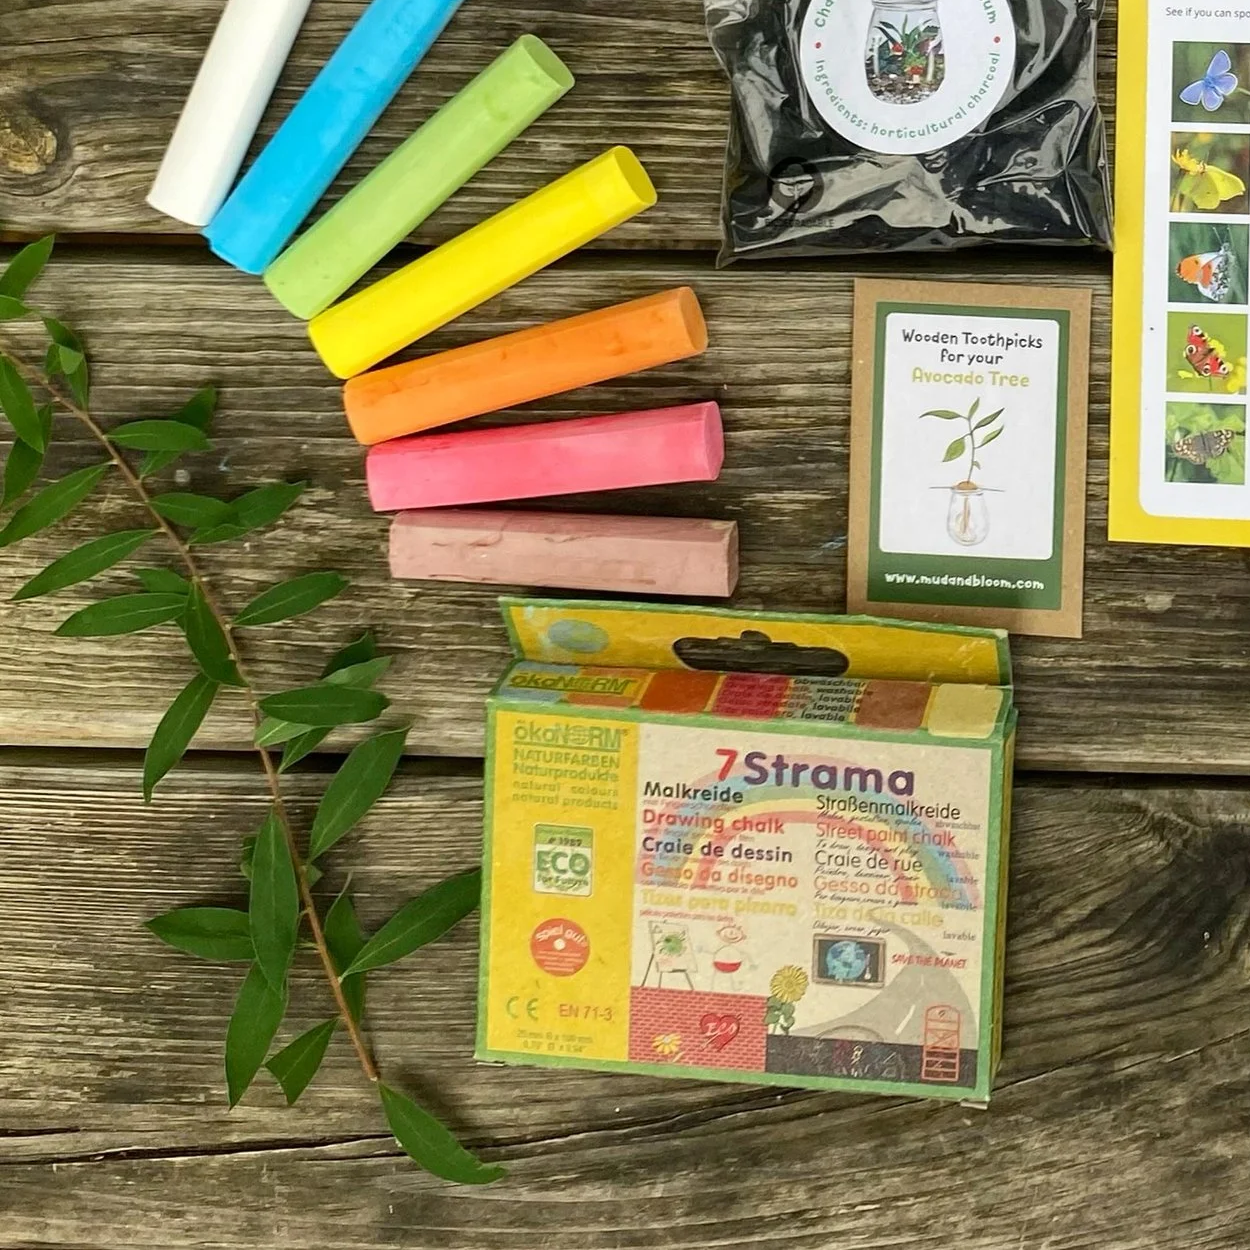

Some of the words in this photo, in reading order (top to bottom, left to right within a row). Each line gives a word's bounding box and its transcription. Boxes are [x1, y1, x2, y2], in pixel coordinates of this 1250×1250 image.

[814, 60, 867, 130] Ingredients:
[871, 107, 968, 138] horticultural
[967, 52, 1001, 109] charcoal
[902, 329, 958, 344] Wooden
[961, 331, 1043, 349] Toothpicks
[940, 348, 965, 363] for
[967, 354, 1003, 365] your
[912, 367, 984, 385] Avocado
[987, 370, 1029, 387] Tree
[884, 573, 1044, 590] www.mudandbloom.com
[512, 748, 622, 769] NATURFARBEN
[713, 746, 741, 782] 7
[742, 751, 915, 795] Strama
[642, 781, 743, 803] Malkreide
[815, 795, 962, 821] Straßenmalkreide
[643, 810, 723, 833] Drawing
[733, 814, 785, 835] chalk
[816, 823, 862, 839] Street
[867, 828, 908, 845] paint
[913, 829, 957, 847] chalk
[642, 836, 693, 855] Craie
[701, 841, 724, 857] de
[732, 843, 792, 864] dessin
[814, 850, 863, 870] Craie
[864, 852, 889, 870] de
[893, 854, 923, 873] rue
[535, 850, 592, 874] ECO
[559, 1003, 580, 1018] EN
[584, 1006, 613, 1021] 71-3
